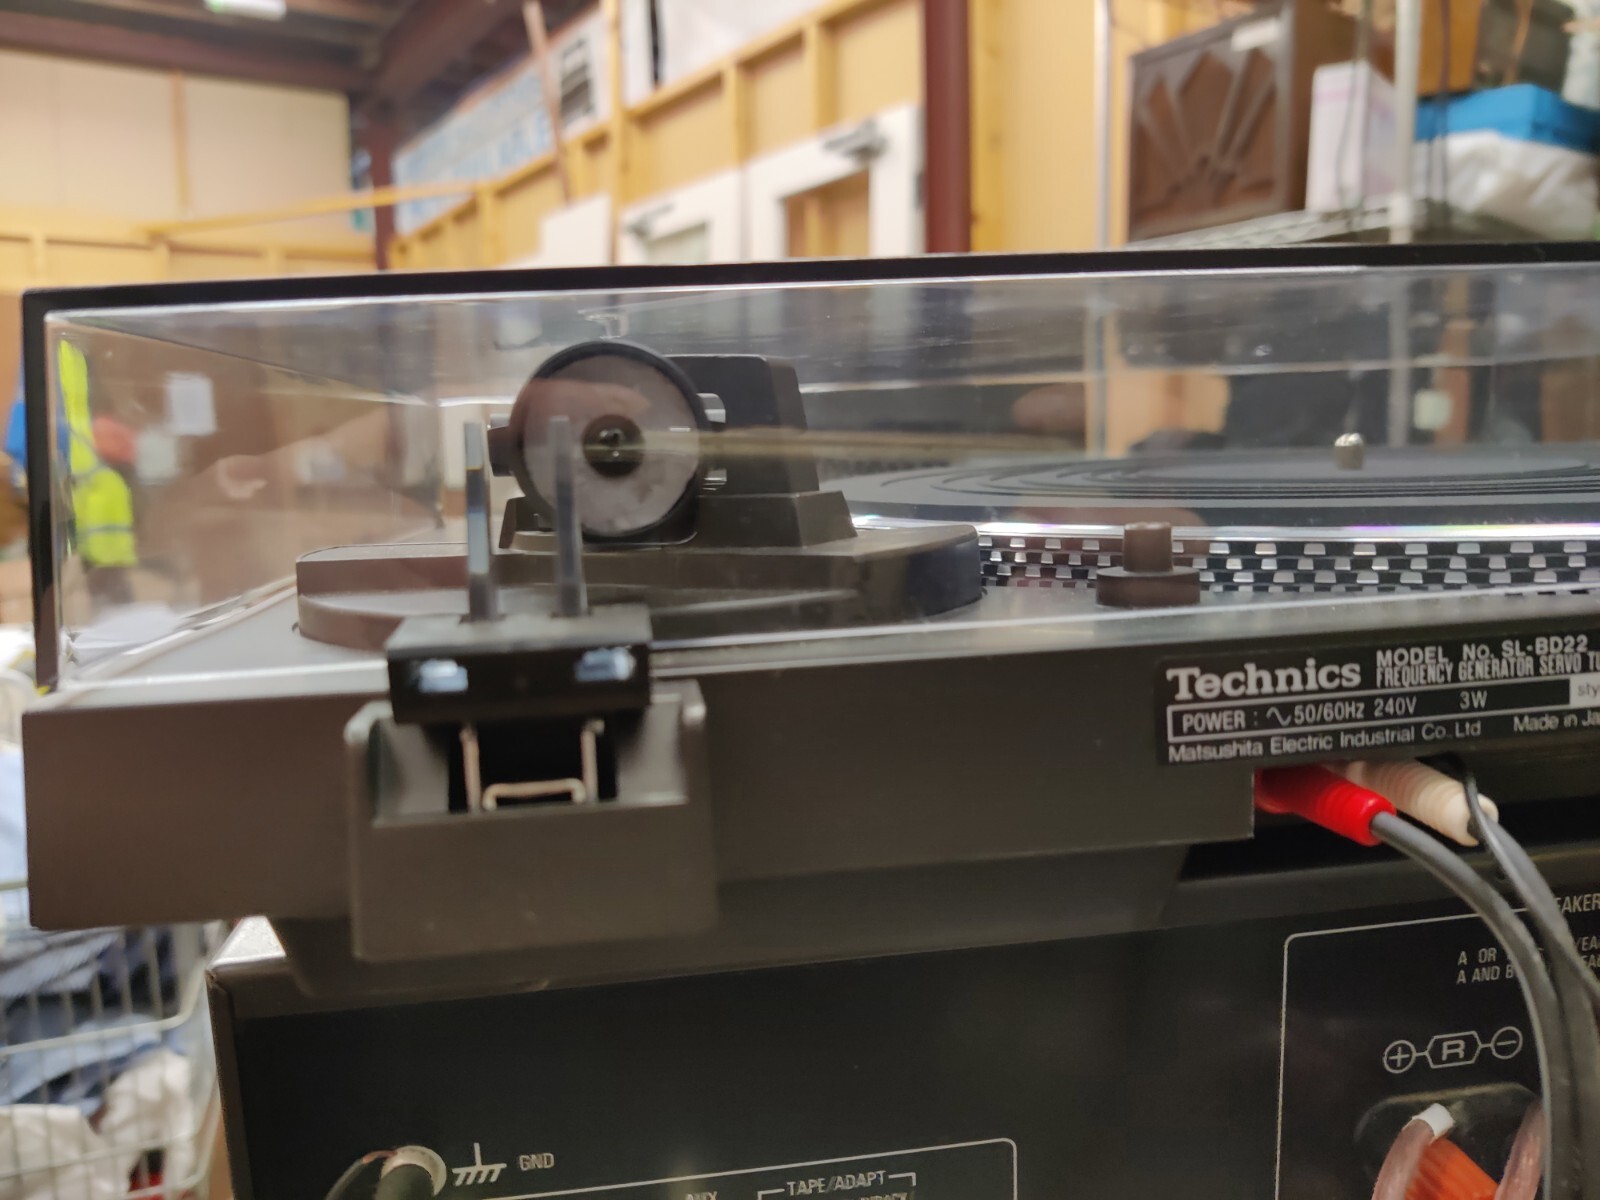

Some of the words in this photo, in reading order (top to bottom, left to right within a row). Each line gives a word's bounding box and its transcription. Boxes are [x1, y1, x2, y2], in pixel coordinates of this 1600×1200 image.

[1376, 645, 1449, 668] MODEL
[1462, 643, 1495, 661] NO.
[1501, 634, 1589, 659] SL-BD22
[1166, 657, 1362, 701] Technics
[1375, 662, 1454, 688] FREQUENCY
[1458, 655, 1534, 682] GENERATOR
[1539, 652, 1582, 675] SERVO
[1182, 709, 1246, 734] POWER
[1294, 701, 1365, 725] 50/60Hz
[1373, 695, 1417, 718] 240V
[1459, 690, 1488, 710] 3W
[1513, 713, 1559, 732] Made
[1564, 713, 1578, 727] in
[1168, 740, 1264, 763] Matsushita
[1270, 733, 1334, 756] Electric
[1340, 725, 1415, 748] Industrial
[1455, 720, 1482, 738] Ltd
[1457, 950, 1468, 966] A
[1478, 947, 1498, 964] OR
[1456, 969, 1467, 985] A
[1471, 965, 1501, 983] AND
[1441, 1040, 1465, 1061] R
[519, 1152, 555, 1171] GND
[786, 1169, 886, 1196] TAPE/ADAPT
